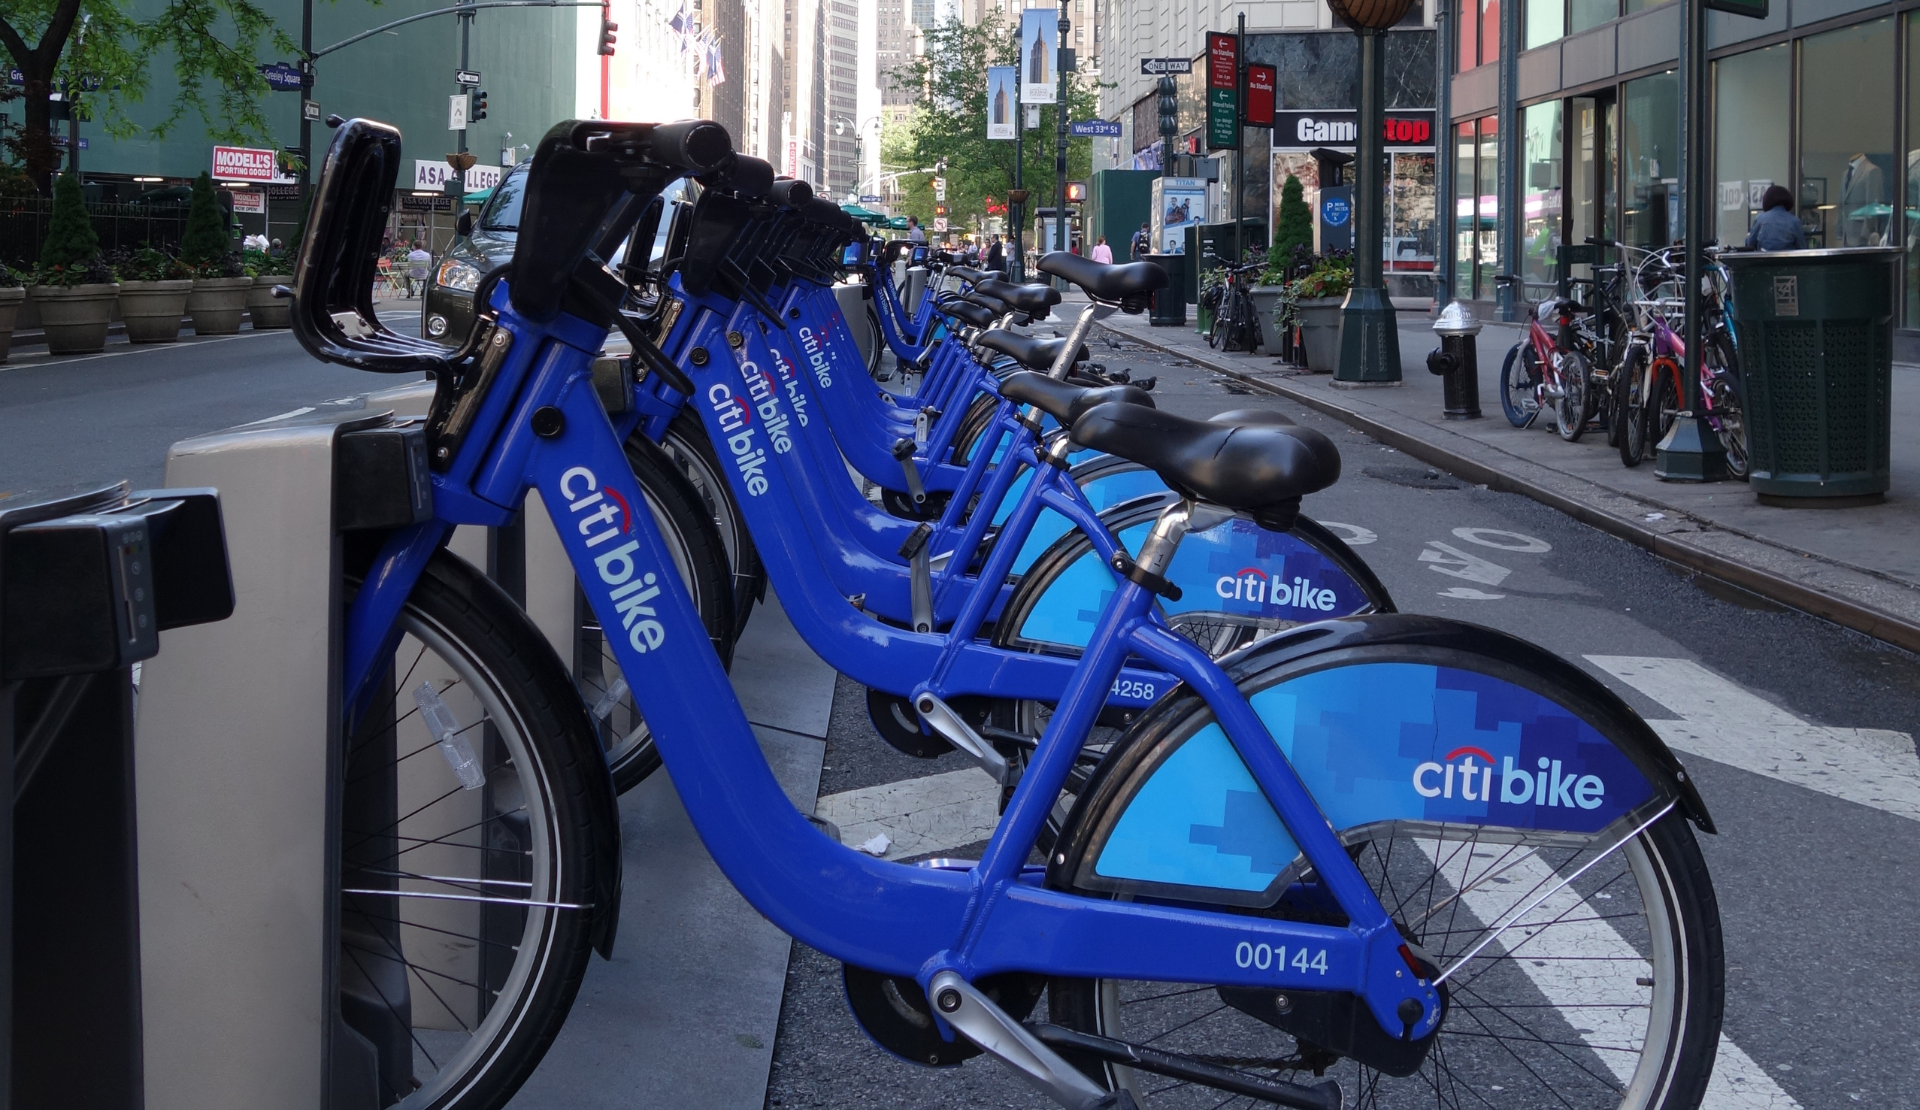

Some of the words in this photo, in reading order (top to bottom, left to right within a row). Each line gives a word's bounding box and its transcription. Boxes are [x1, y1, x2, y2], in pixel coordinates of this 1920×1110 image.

[265, 69, 283, 83] Greeley
[284, 72, 300, 85] Square
[1256, 83, 1272, 92] Standing
[1075, 125, 1094, 133] West
[1095, 125, 1109, 133] 33rd
[1297, 118, 1430, 143] Gamtop
[216, 166, 248, 175] SPORTING
[249, 168, 271, 176] GOODS
[217, 151, 271, 168] MODELL'S
[419, 166, 445, 185] ASA
[1327, 203, 1333, 211] P
[799, 327, 819, 354] citi
[810, 351, 832, 389] bike
[709, 383, 747, 433] citi
[740, 361, 772, 401] citi
[757, 398, 792, 454] bike
[727, 428, 768, 497] bike
[560, 467, 625, 548] citi
[594, 539, 665, 653] bike
[1216, 570, 1266, 602] citi
[1270, 575, 1336, 611] bike
[1111, 680, 1154, 700] 4258
[1413, 751, 1494, 802] citi
[1500, 756, 1605, 810] bike
[1235, 941, 1328, 975] 00144
